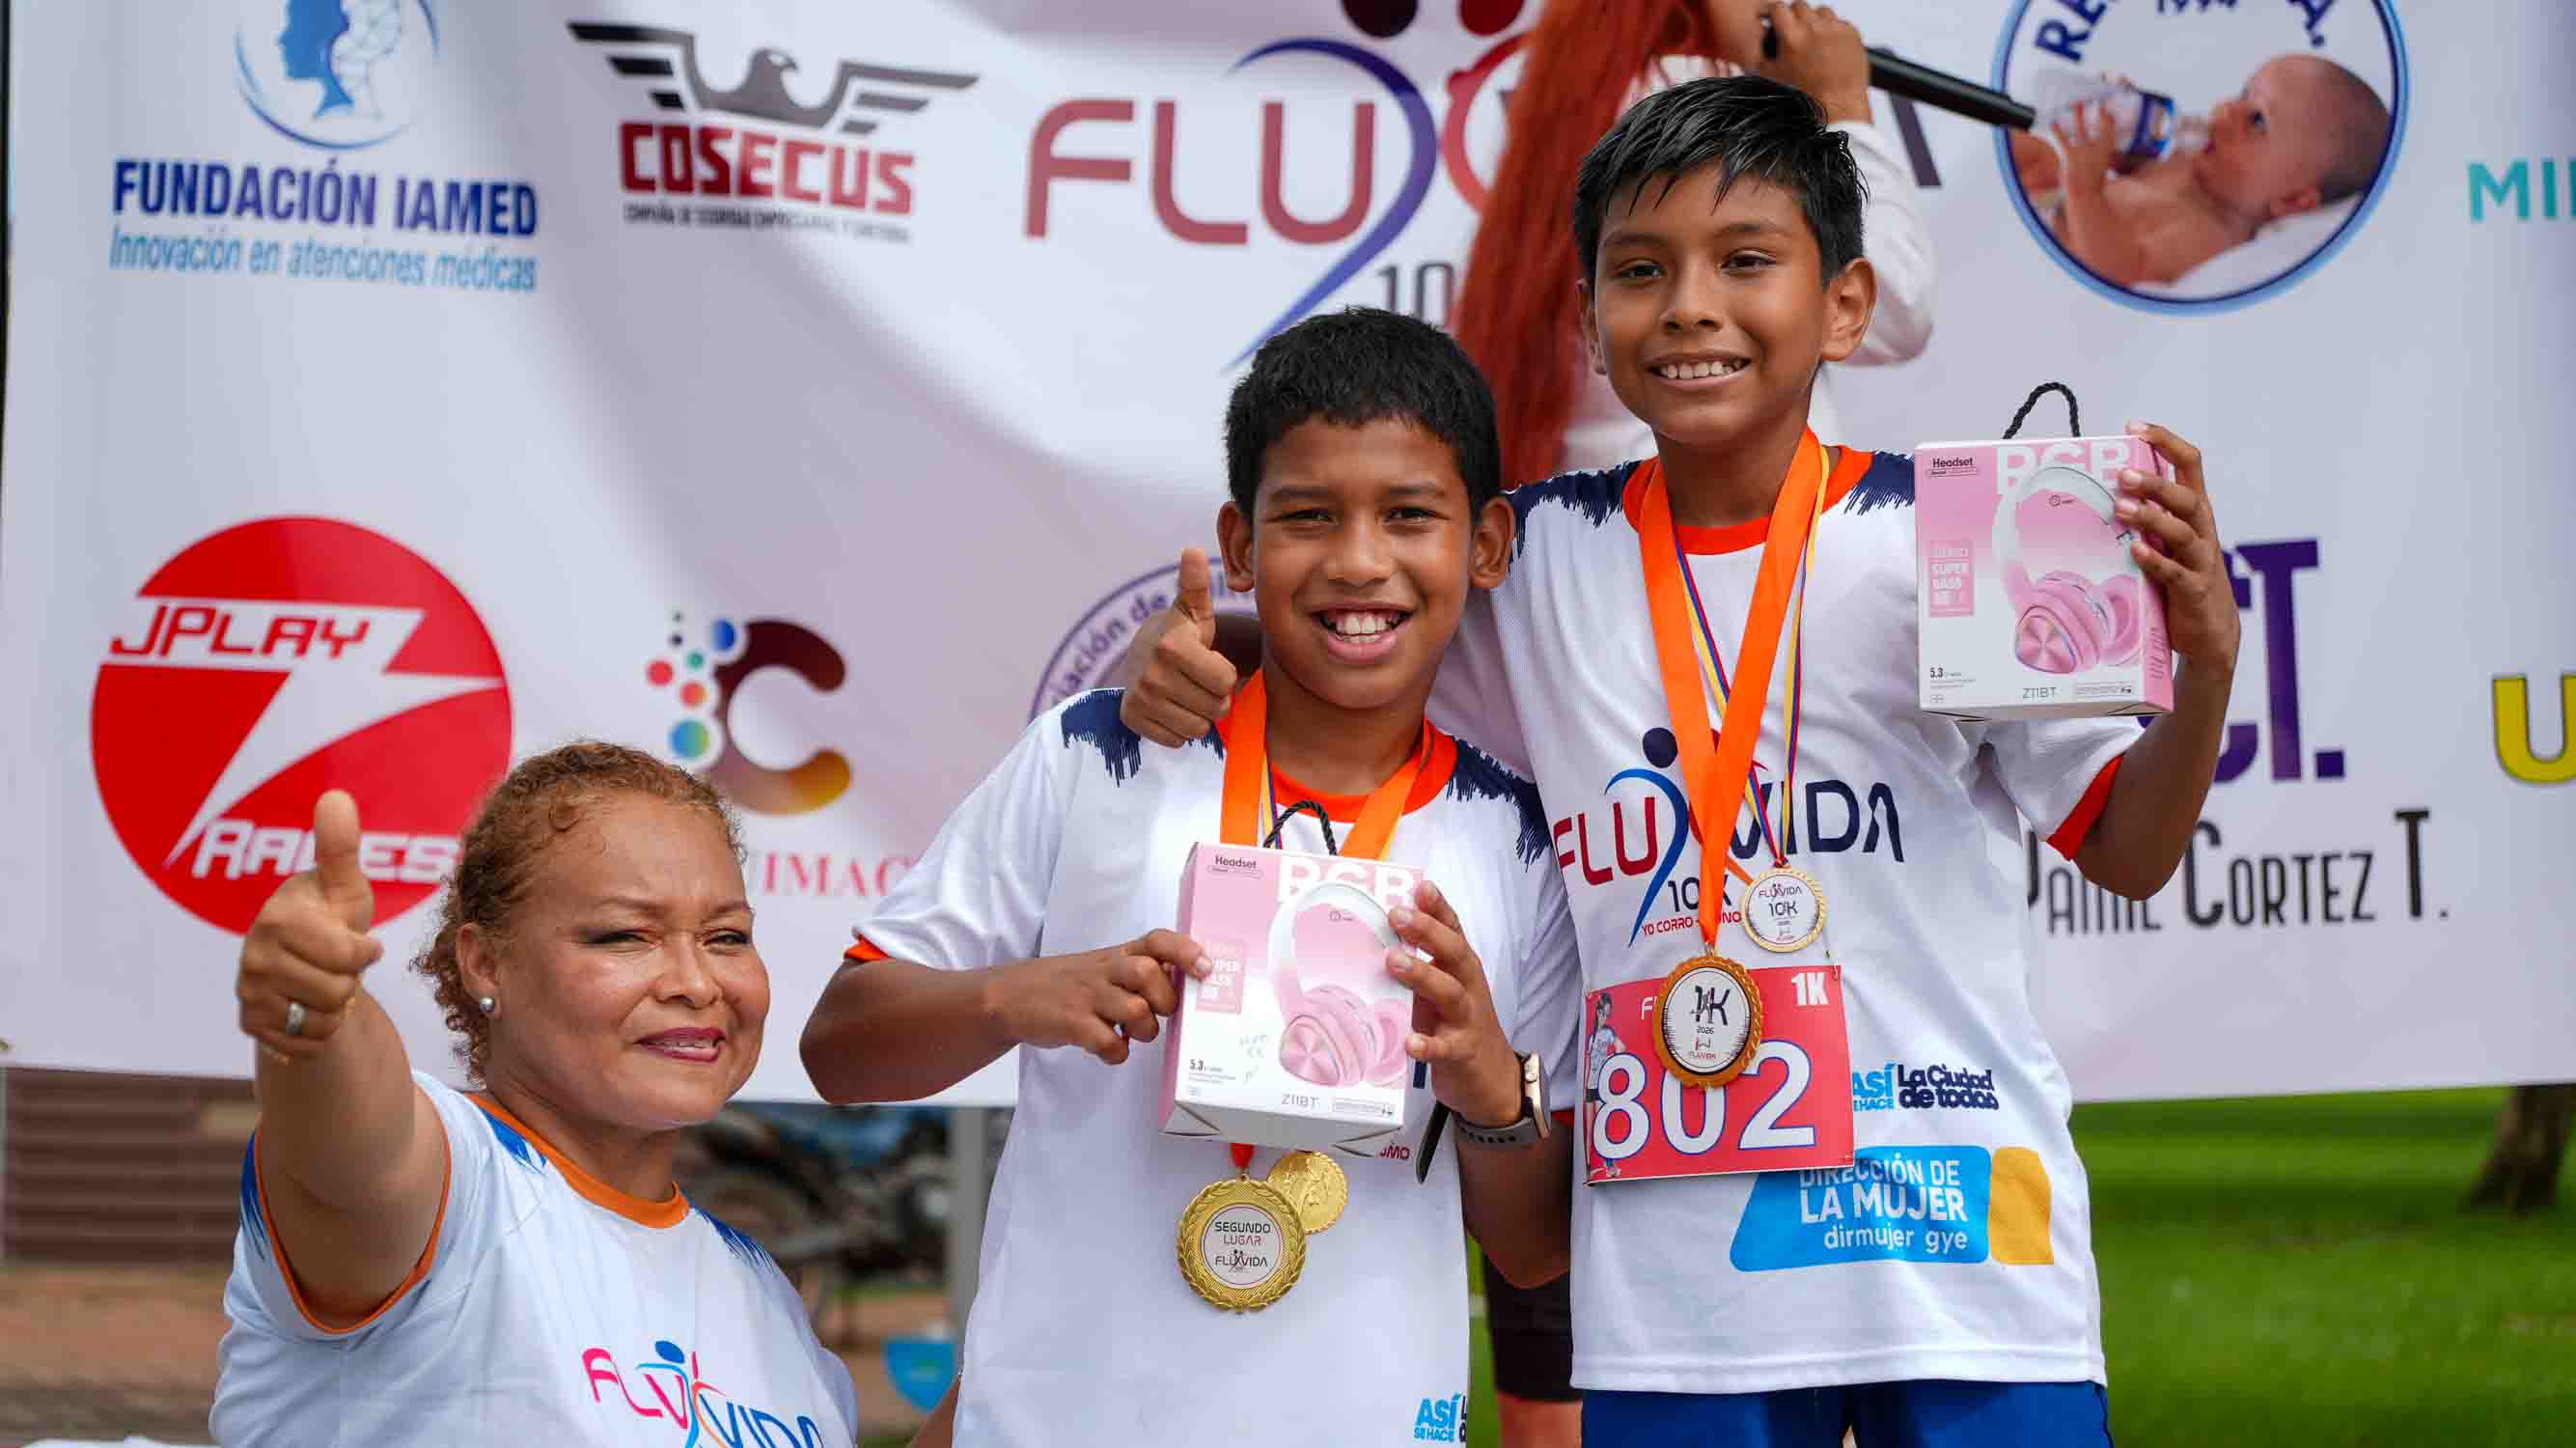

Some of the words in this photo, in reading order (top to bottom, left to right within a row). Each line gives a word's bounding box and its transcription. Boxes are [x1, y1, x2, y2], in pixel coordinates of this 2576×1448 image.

[621, 122, 914, 215] COSECUS
[113, 157, 376, 228] FUNDACIÓN
[394, 178, 537, 237] IAMED
[2469, 158, 2576, 222] MI
[108, 224, 241, 270] Innovación
[248, 238, 280, 274] en
[288, 238, 425, 283] atenciones
[432, 245, 538, 292] médicas
[1932, 457, 1974, 468] Headset
[108, 603, 371, 659] JPLAY
[1930, 667, 1944, 678] 5.3
[1215, 855, 1257, 868] Headset
[1768, 901, 1798, 917] 10K
[1642, 924, 1654, 935] YO
[1657, 916, 1694, 933] CORRO
[1790, 972, 1830, 1007] 1K
[1694, 986, 1731, 1026] 1K
[1897, 1064, 1926, 1087] La
[1927, 1063, 1994, 1091] Ciudad
[1593, 1040, 1816, 1160] 802
[1898, 1084, 1934, 1109] de
[1936, 1087, 1999, 1110] todos
[1930, 1160, 1961, 1186] DE
[1800, 1186, 1844, 1225] LA
[1852, 1183, 1970, 1223] MUJER
[1215, 1221, 1271, 1234] SEGUNDO
[1224, 1235, 1261, 1245] LUGAR
[1415, 1392, 1461, 1429] ASÍ
